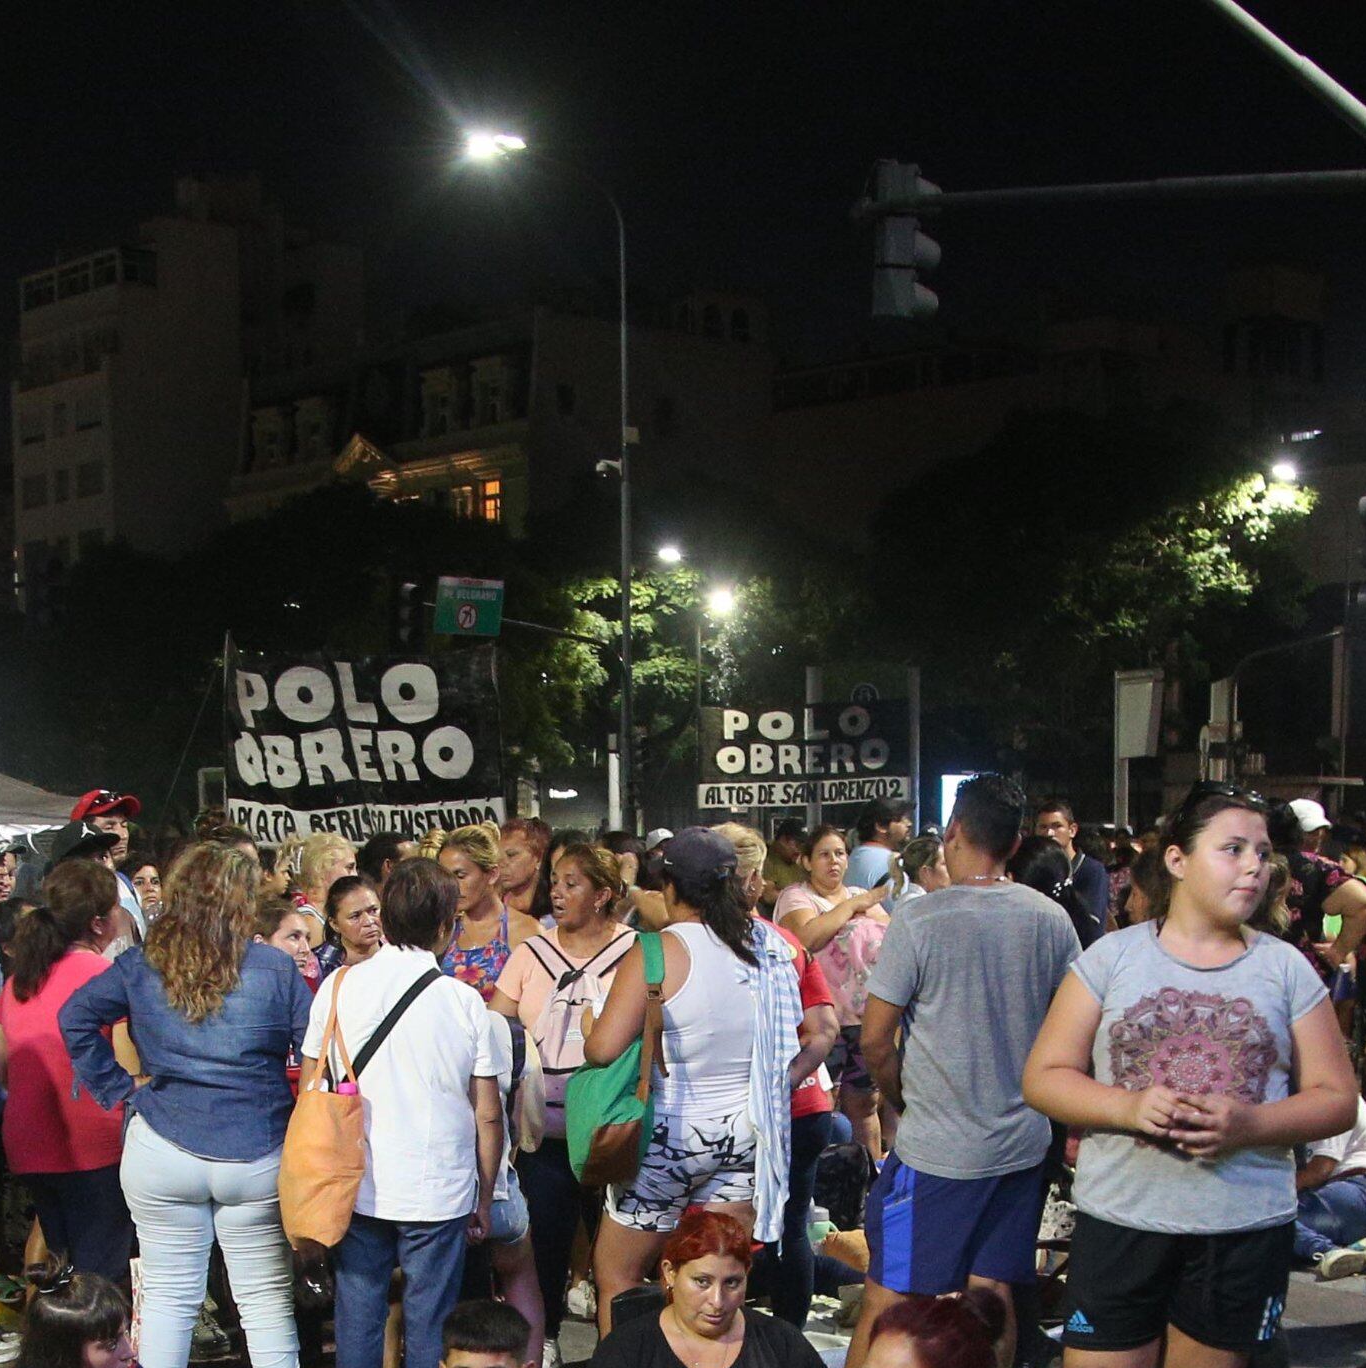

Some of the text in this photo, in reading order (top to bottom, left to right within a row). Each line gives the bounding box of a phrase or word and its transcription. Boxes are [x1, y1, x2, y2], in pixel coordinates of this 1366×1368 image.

[236, 661, 439, 728] POLO
[723, 706, 871, 741] POLO
[235, 726, 474, 789] OBRERO
[716, 738, 890, 775] OBRERO
[705, 778, 903, 805] ALTOS DE SAN LORENZO 2
